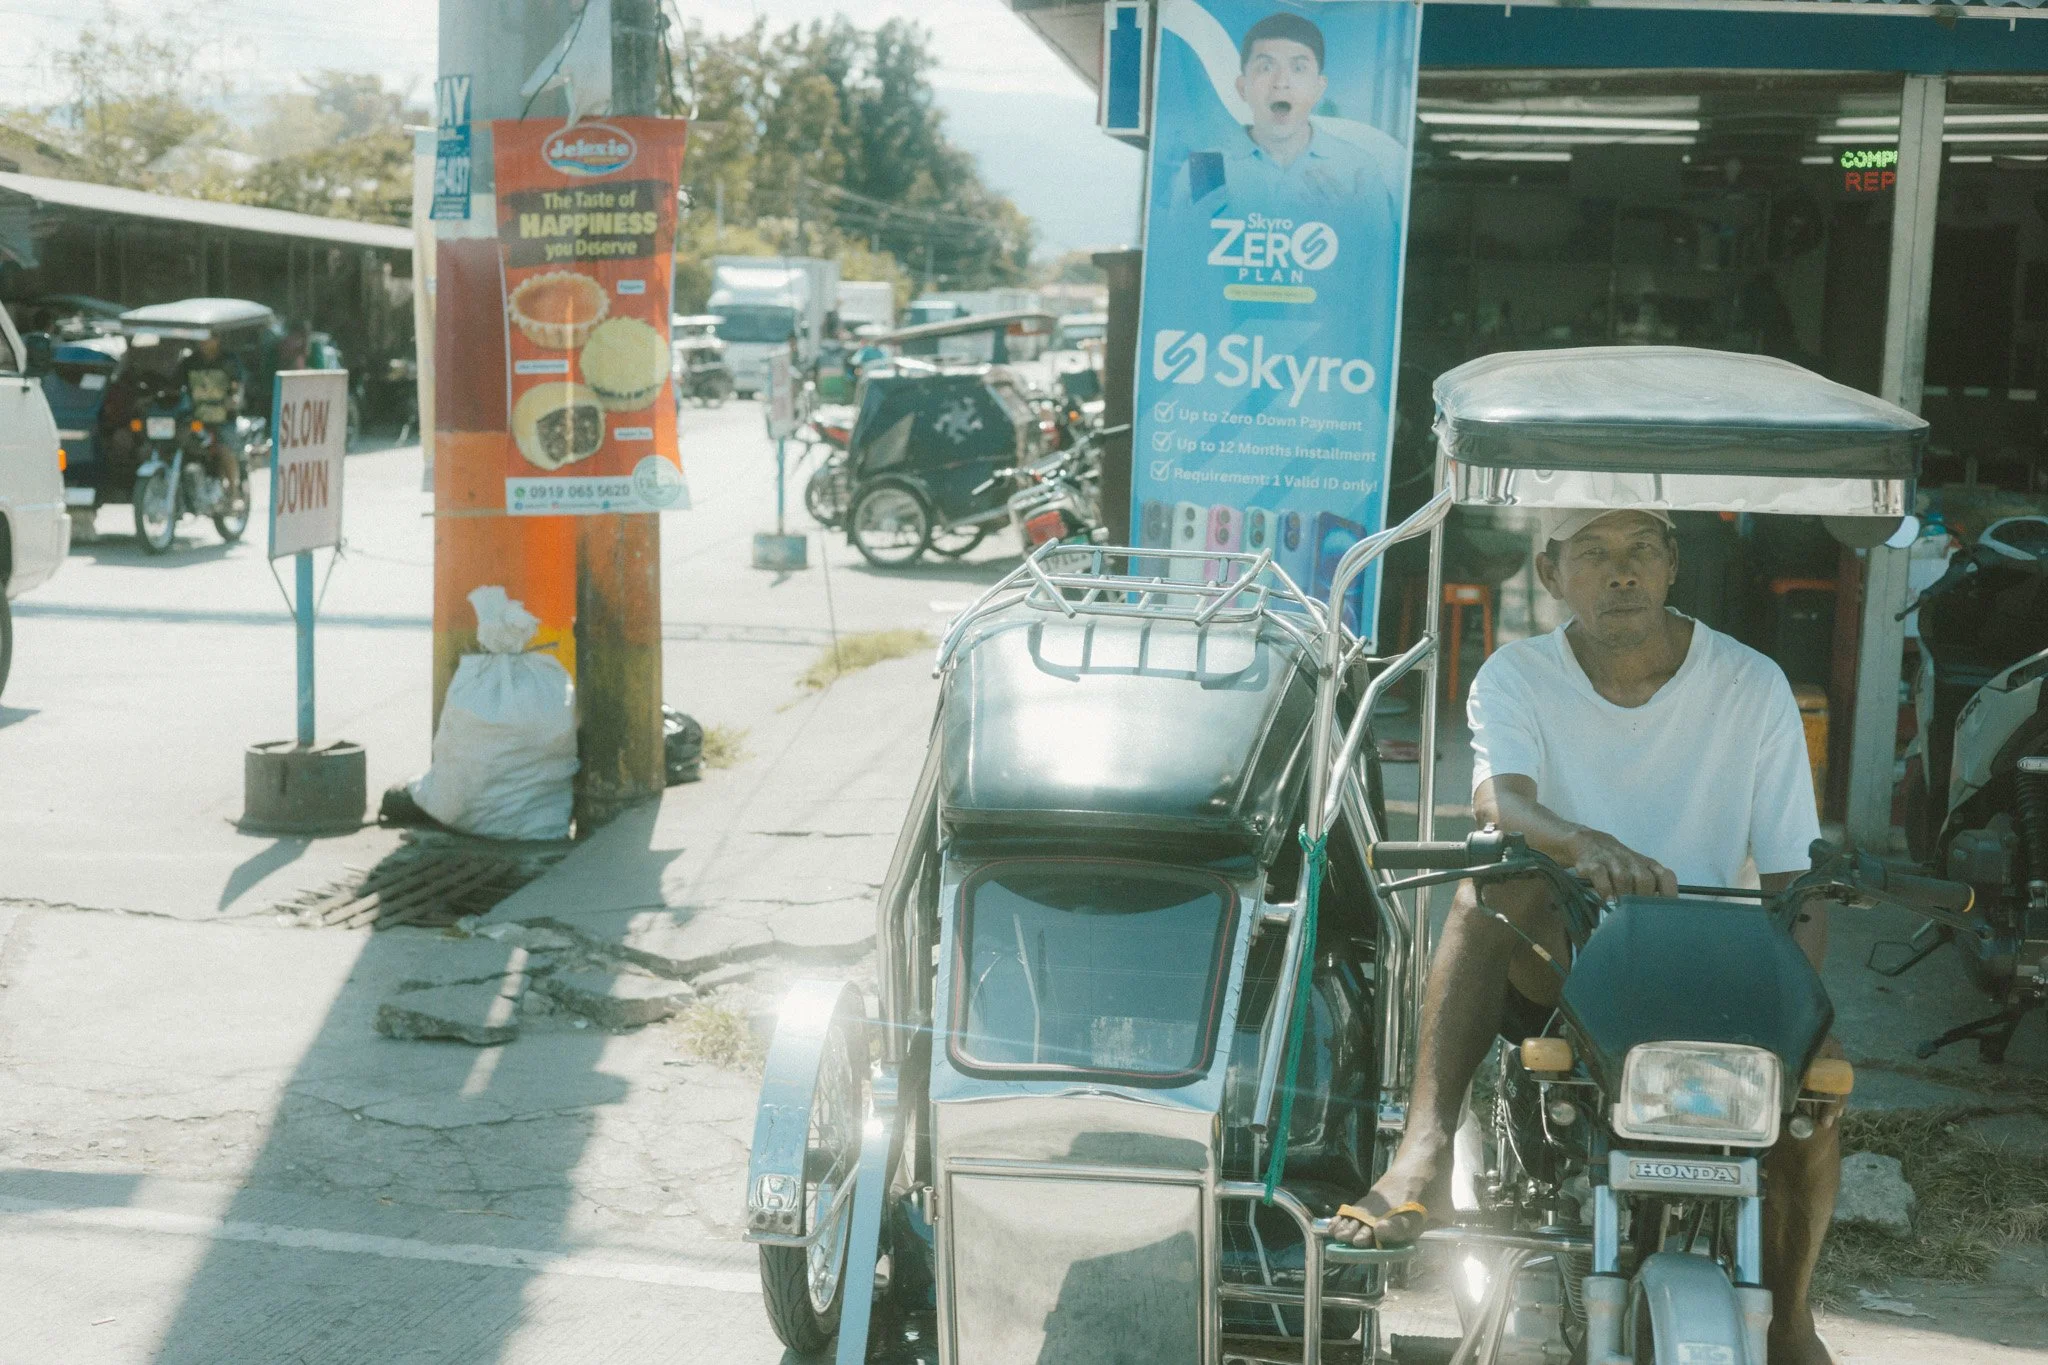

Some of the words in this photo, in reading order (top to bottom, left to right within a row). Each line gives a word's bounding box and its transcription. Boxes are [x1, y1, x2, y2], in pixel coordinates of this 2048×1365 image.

[543, 192, 572, 210] The
[575, 191, 614, 208] Taste
[618, 189, 637, 208] of
[520, 212, 658, 239] HAPPINESS
[1247, 212, 1294, 235] Skyro
[544, 243, 573, 261] you
[575, 240, 637, 256] Deserve
[1238, 267, 1303, 283] PLAN
[1214, 333, 1376, 408] Skyro
[279, 400, 330, 448] SLOW
[1179, 409, 1199, 424] Up
[1202, 411, 1218, 423] to
[1221, 412, 1253, 425] Zero
[1256, 413, 1296, 427] Down
[1300, 416, 1363, 432] Payment
[1176, 439, 1197, 453] Up
[1200, 441, 1216, 453] to
[1219, 441, 1235, 454] 12
[1238, 443, 1292, 457] Months
[1295, 446, 1377, 462] Installment
[1174, 467, 1270, 486] Requirement:
[1273, 474, 1280, 487] 1
[1284, 475, 1320, 488] Valid
[1323, 477, 1339, 490] ID
[1342, 479, 1378, 496] only!
[1636, 1164, 1735, 1183] HONDA
